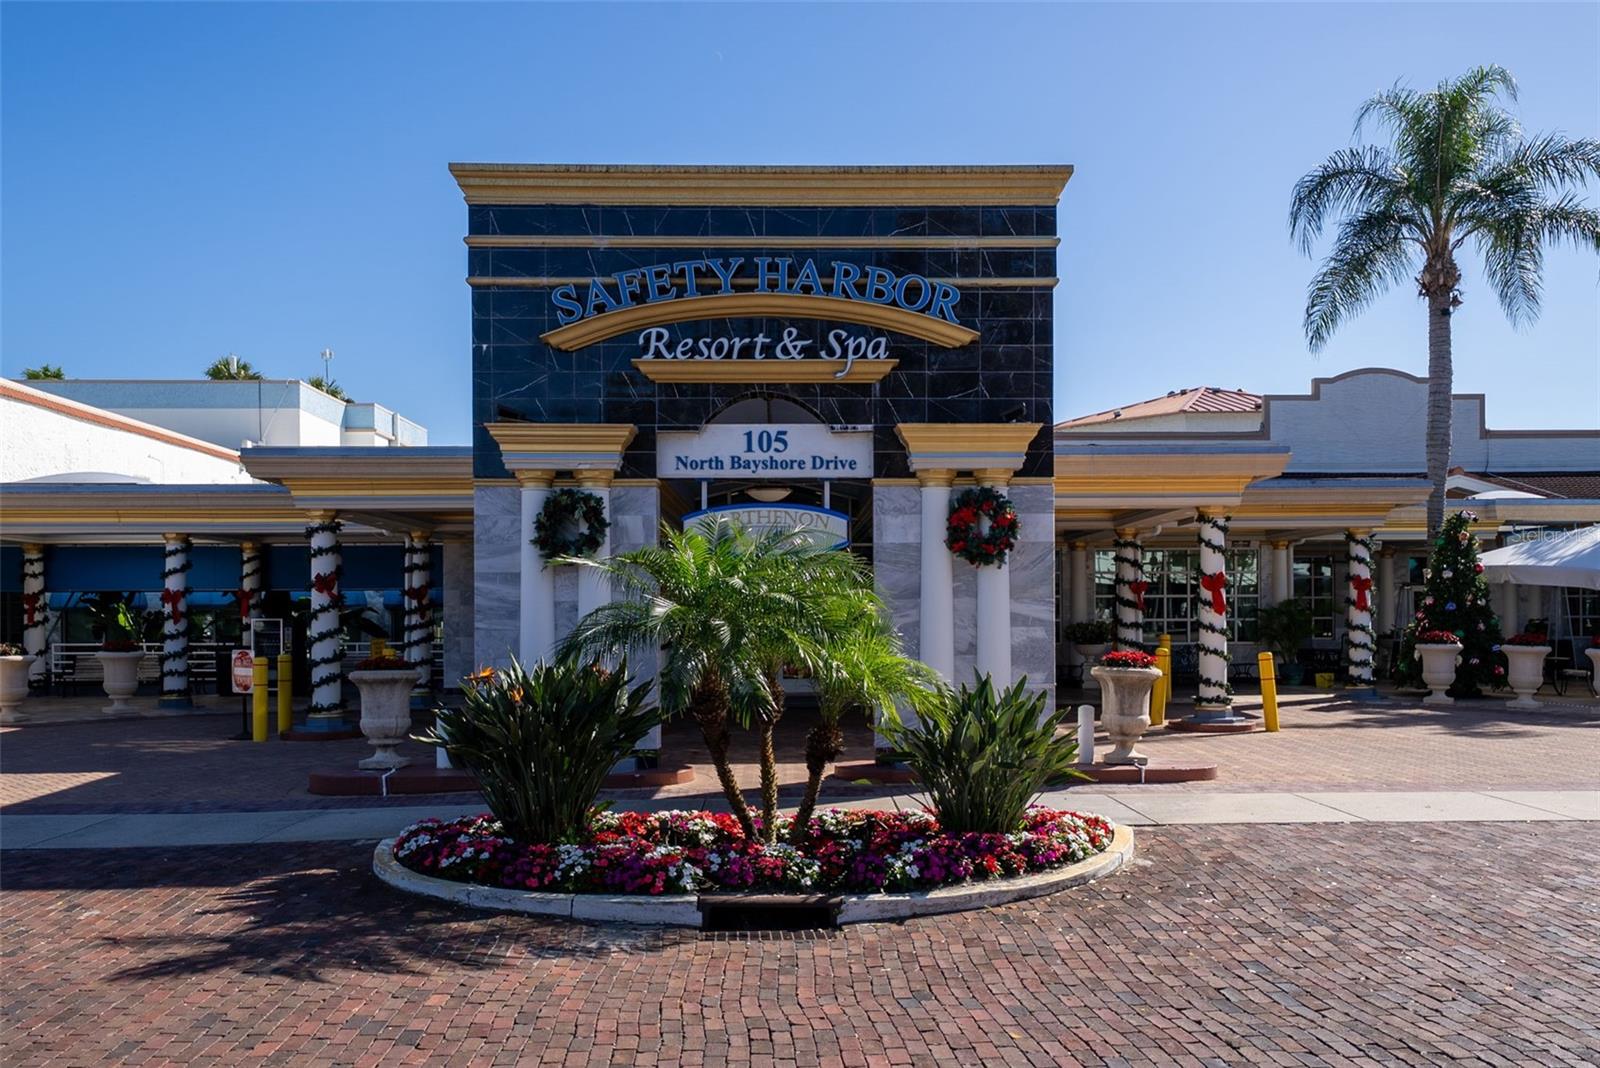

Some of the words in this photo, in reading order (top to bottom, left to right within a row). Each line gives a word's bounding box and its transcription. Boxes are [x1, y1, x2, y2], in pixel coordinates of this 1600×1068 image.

[551, 257, 744, 325] SAFETY
[754, 257, 960, 324] HARBOR
[638, 327, 771, 360] Resort
[775, 327, 812, 360] &
[819, 328, 889, 379] Spa
[743, 430, 788, 453] 105
[675, 456, 724, 470] North
[729, 456, 806, 473] Bayshore
[811, 456, 857, 470] Drive
